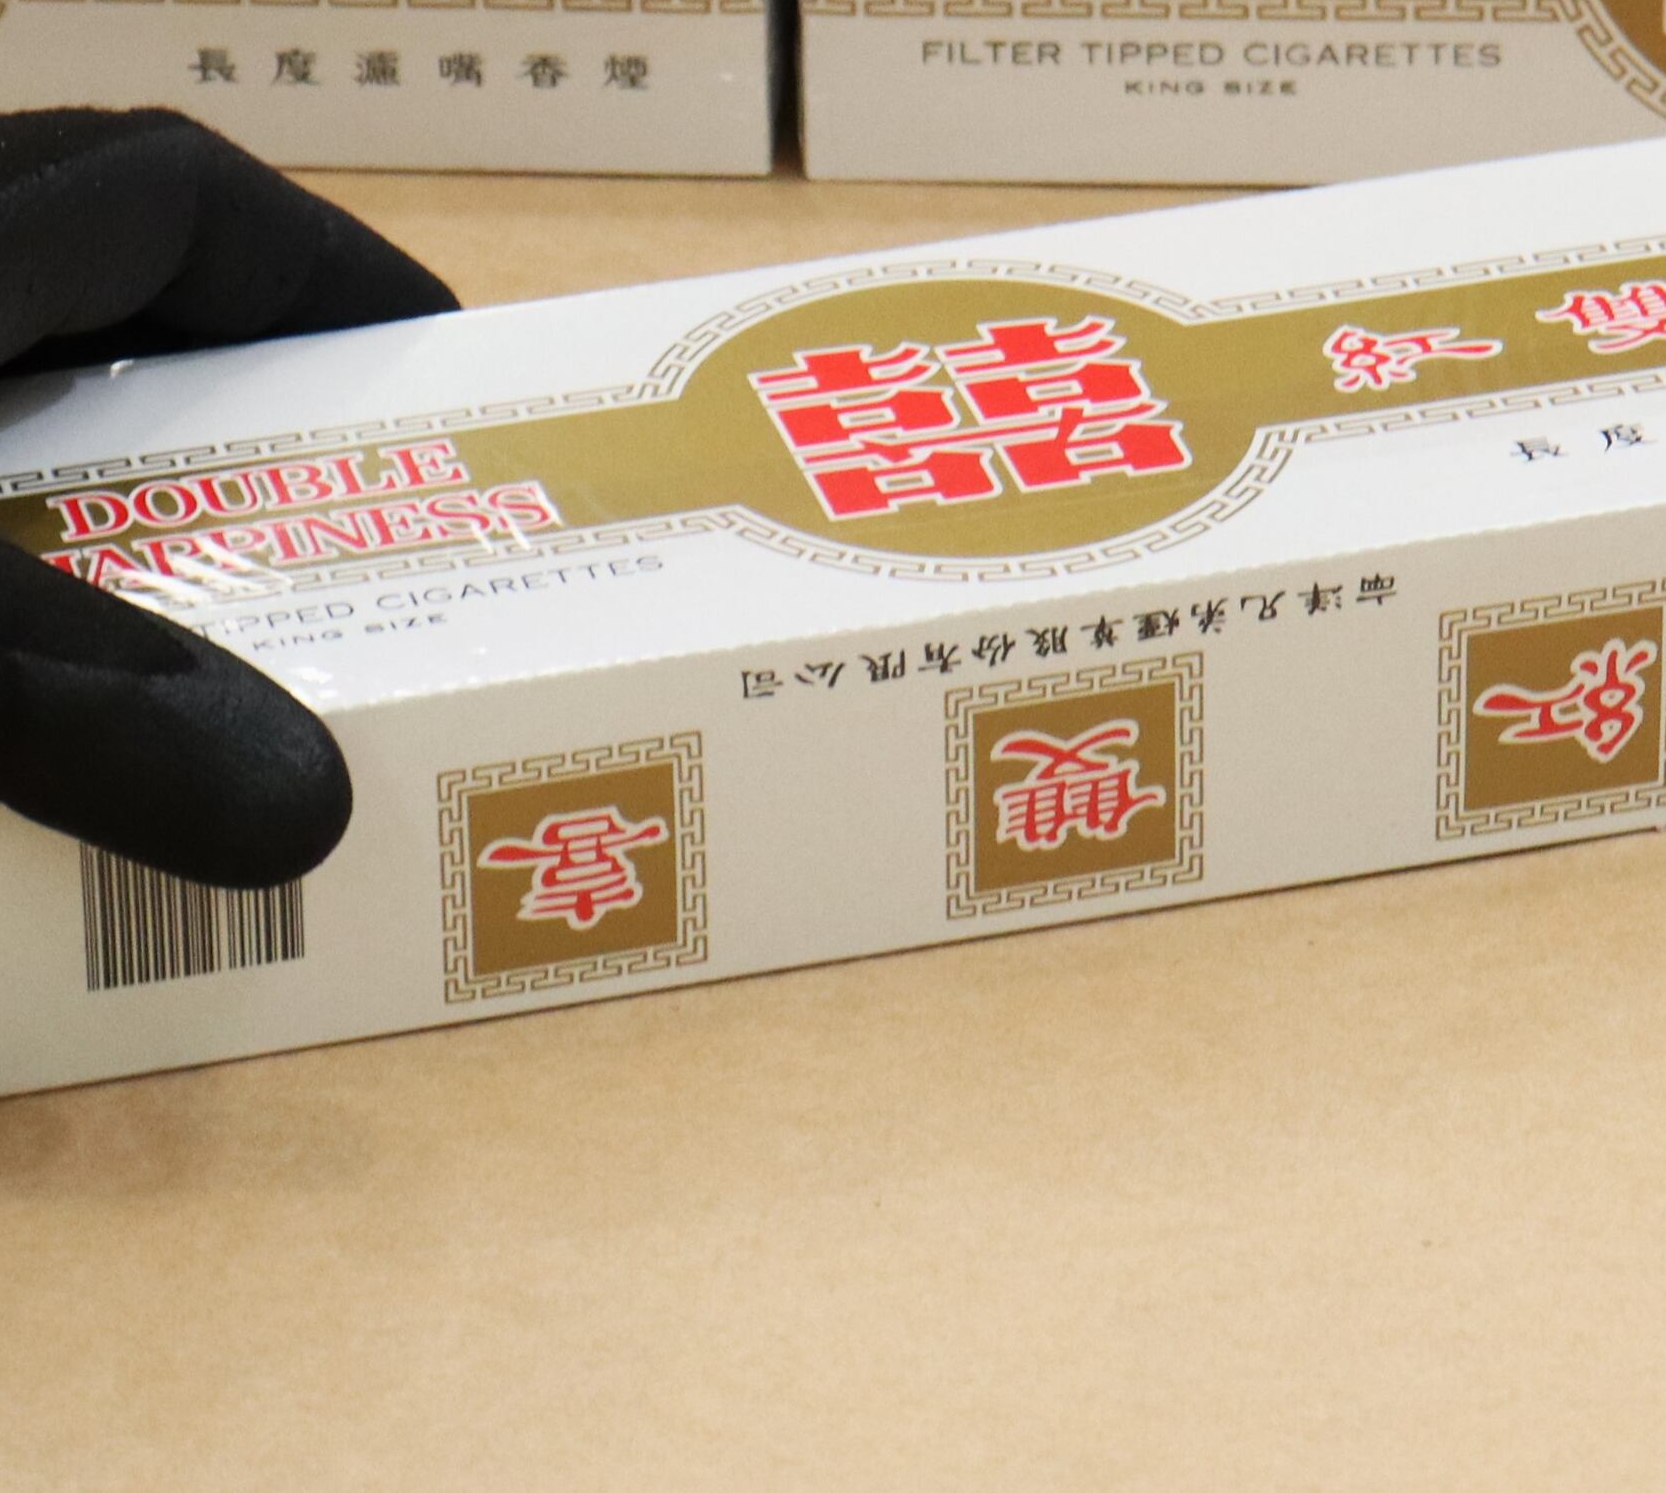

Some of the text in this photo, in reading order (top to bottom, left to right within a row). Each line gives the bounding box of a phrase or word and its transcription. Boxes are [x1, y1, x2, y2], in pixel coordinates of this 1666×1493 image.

[921, 40, 1503, 68] FILTER TIPPED CIGARETTES
[1123, 79, 1298, 96] KING SIZE
[46, 438, 471, 543] DOUBLE
[375, 554, 666, 613] CIGARETTES
[251, 612, 450, 652] KING SIZE
[1472, 636, 1660, 764] 紅
[990, 717, 1167, 851] 雙
[475, 803, 671, 931] 喜
